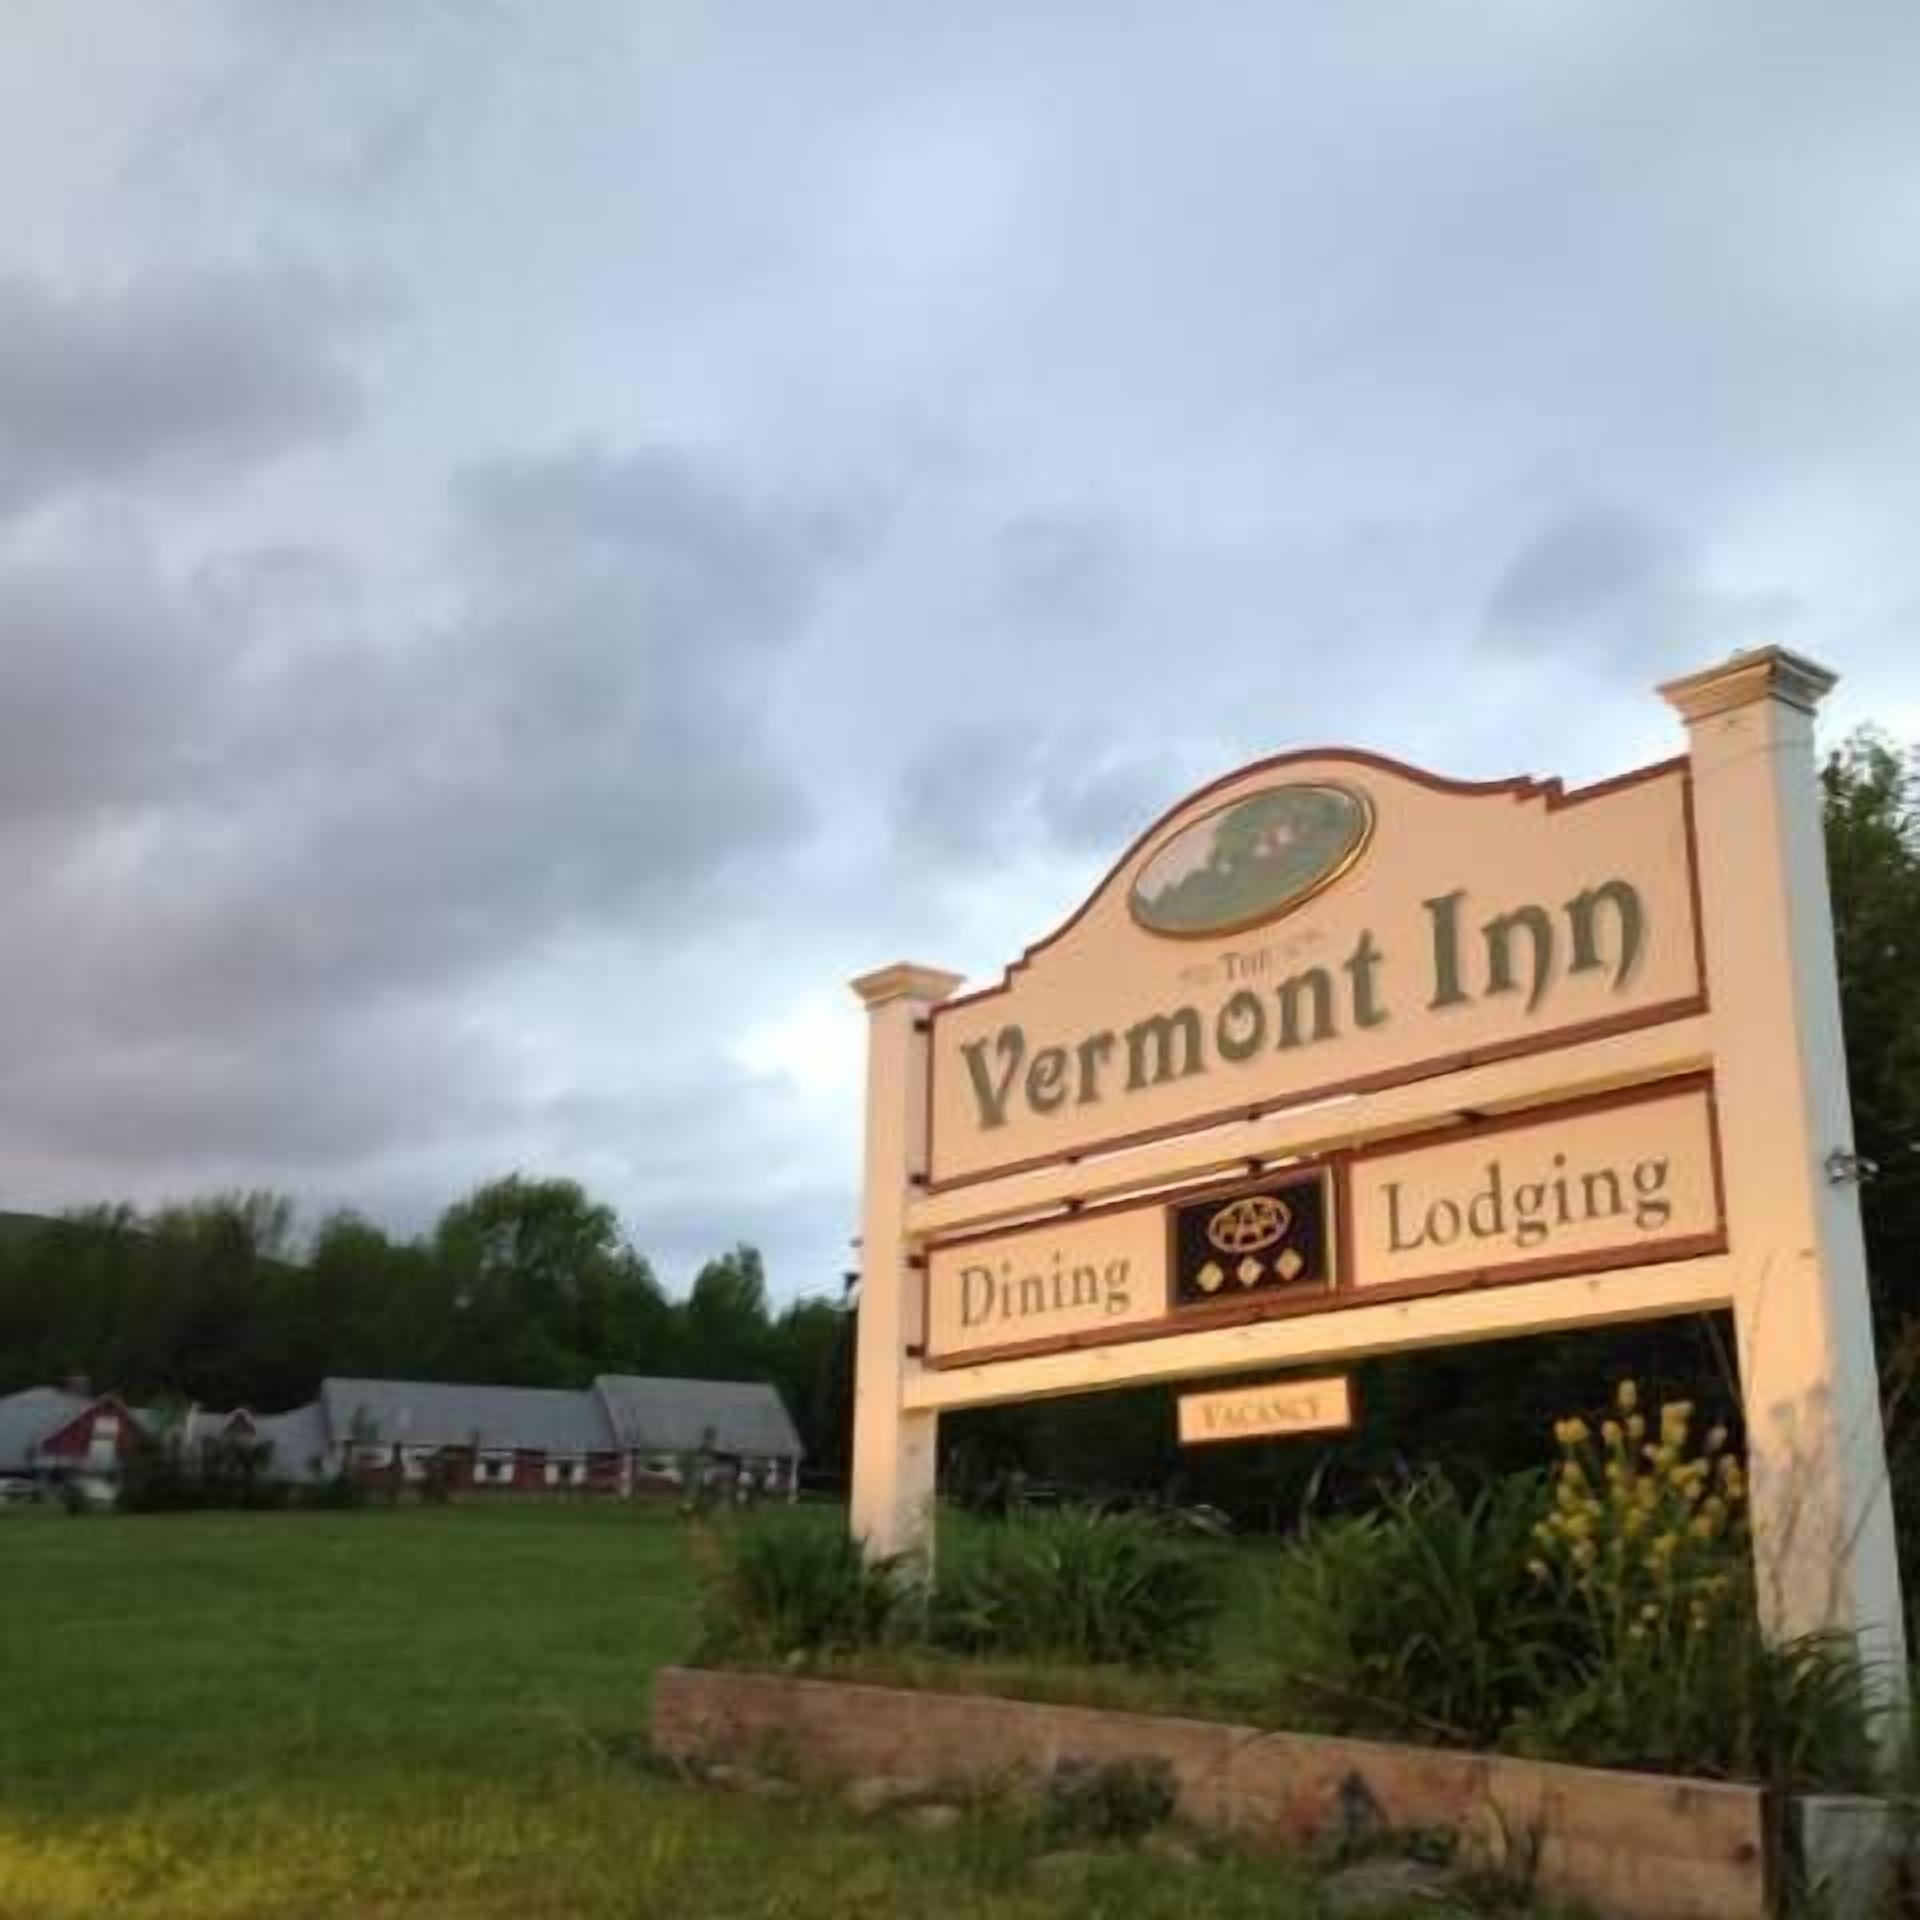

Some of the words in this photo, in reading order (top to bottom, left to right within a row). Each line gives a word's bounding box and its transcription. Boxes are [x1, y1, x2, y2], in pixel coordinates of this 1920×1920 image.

[959, 929, 1392, 1127] Vermont
[1422, 877, 1647, 1014] Inn
[1380, 1153, 1671, 1253] Lodging
[958, 1251, 1132, 1328] Dining
